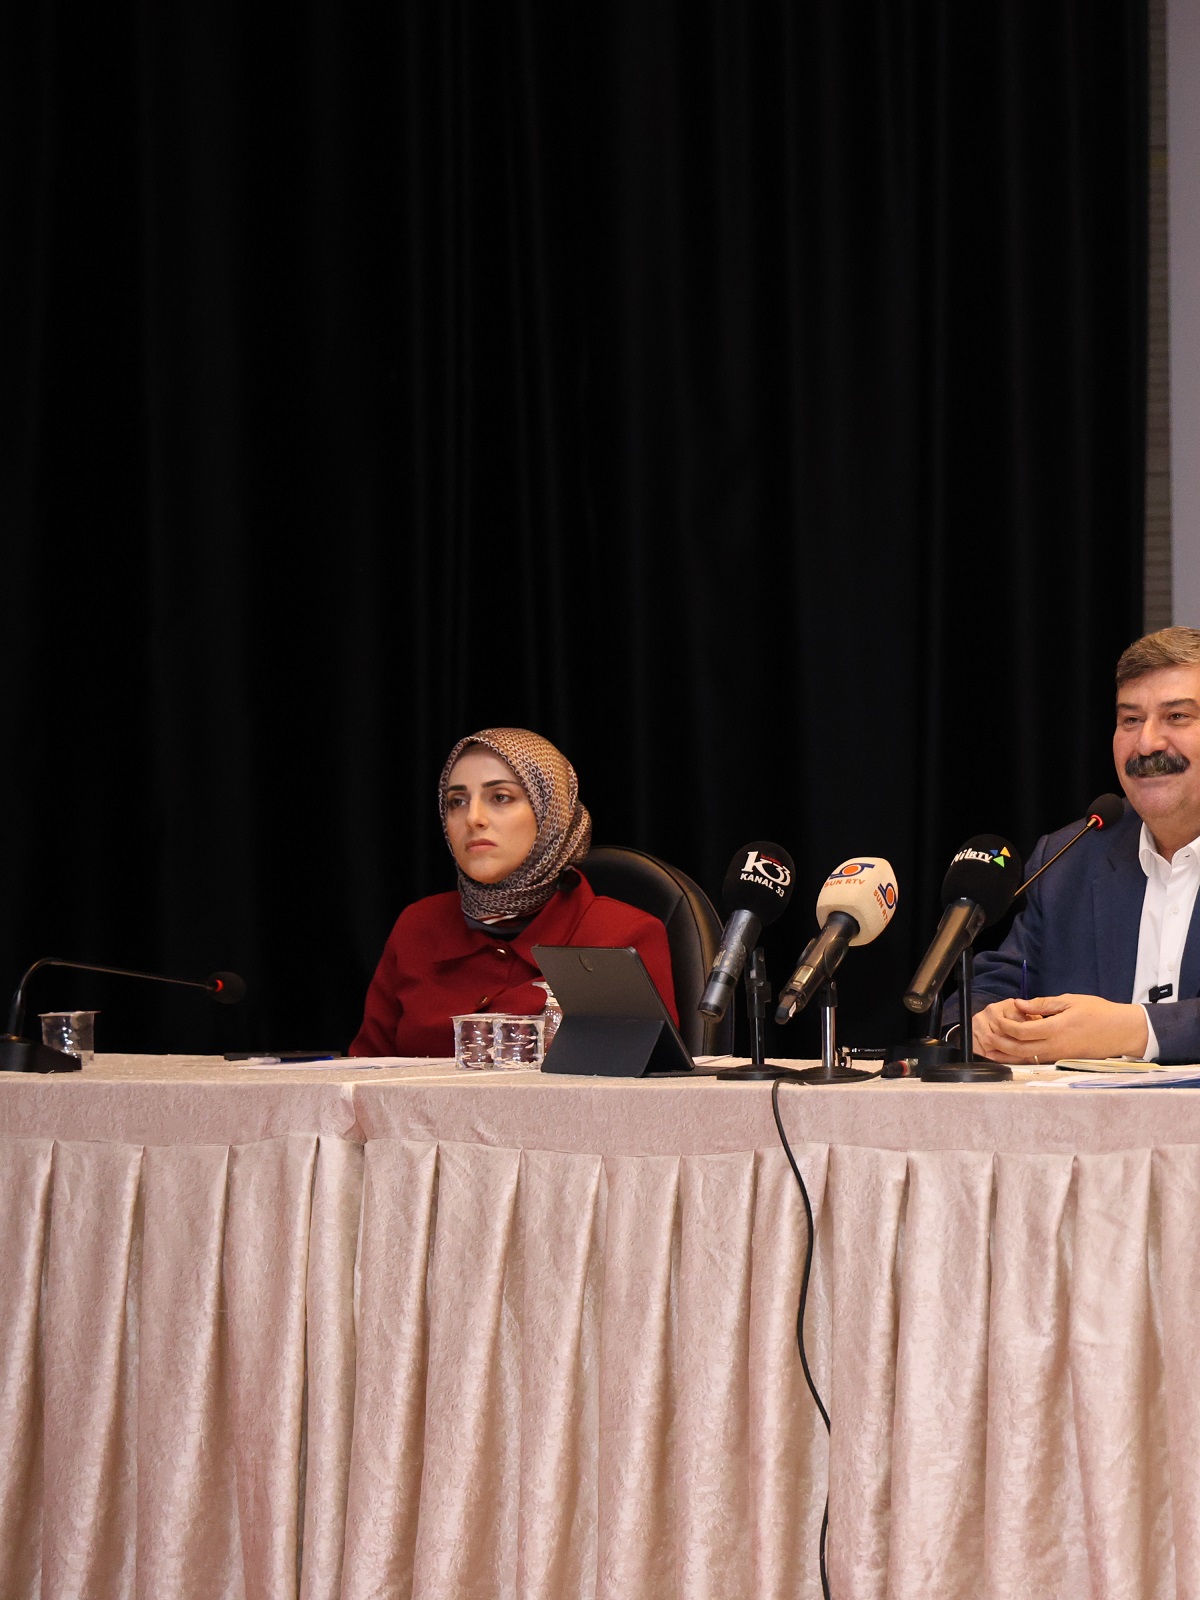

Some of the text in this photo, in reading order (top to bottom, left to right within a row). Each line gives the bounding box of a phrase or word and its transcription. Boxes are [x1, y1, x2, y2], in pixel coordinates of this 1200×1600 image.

[740, 872, 785, 898] KANAL 33
[824, 879, 843, 888] SUN
[873, 889, 884, 909] SUN
